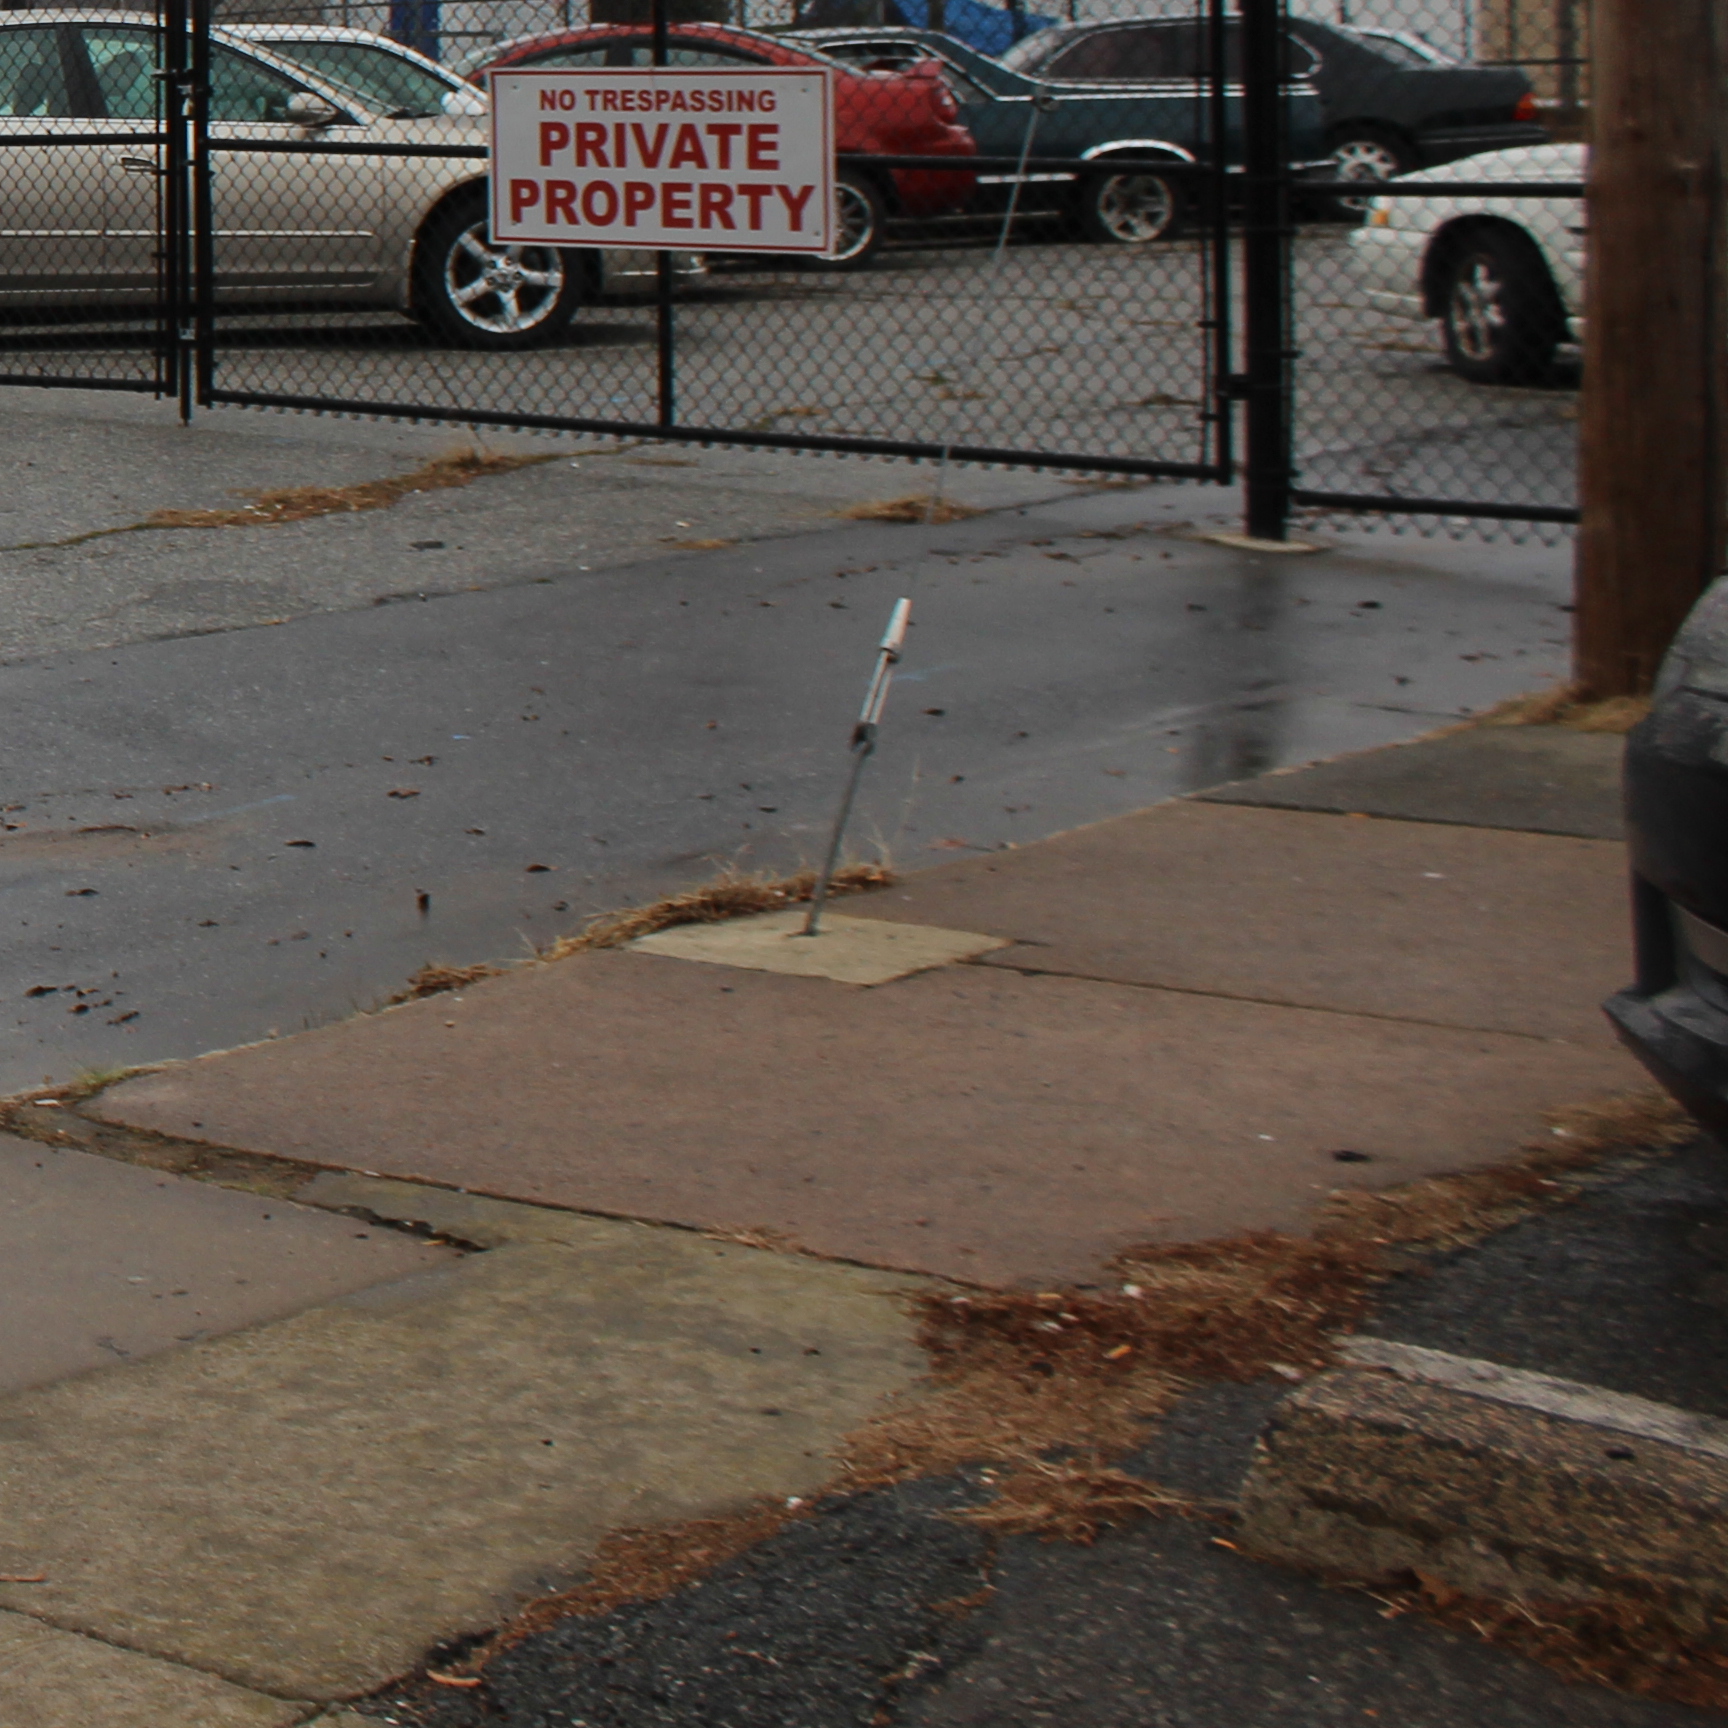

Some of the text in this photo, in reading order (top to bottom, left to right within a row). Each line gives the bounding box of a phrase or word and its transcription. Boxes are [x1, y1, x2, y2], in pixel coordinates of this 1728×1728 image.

[538, 88, 777, 113] NO TRESPASSING
[538, 121, 781, 171] PRIVATE
[509, 178, 816, 232] PROPERTY
